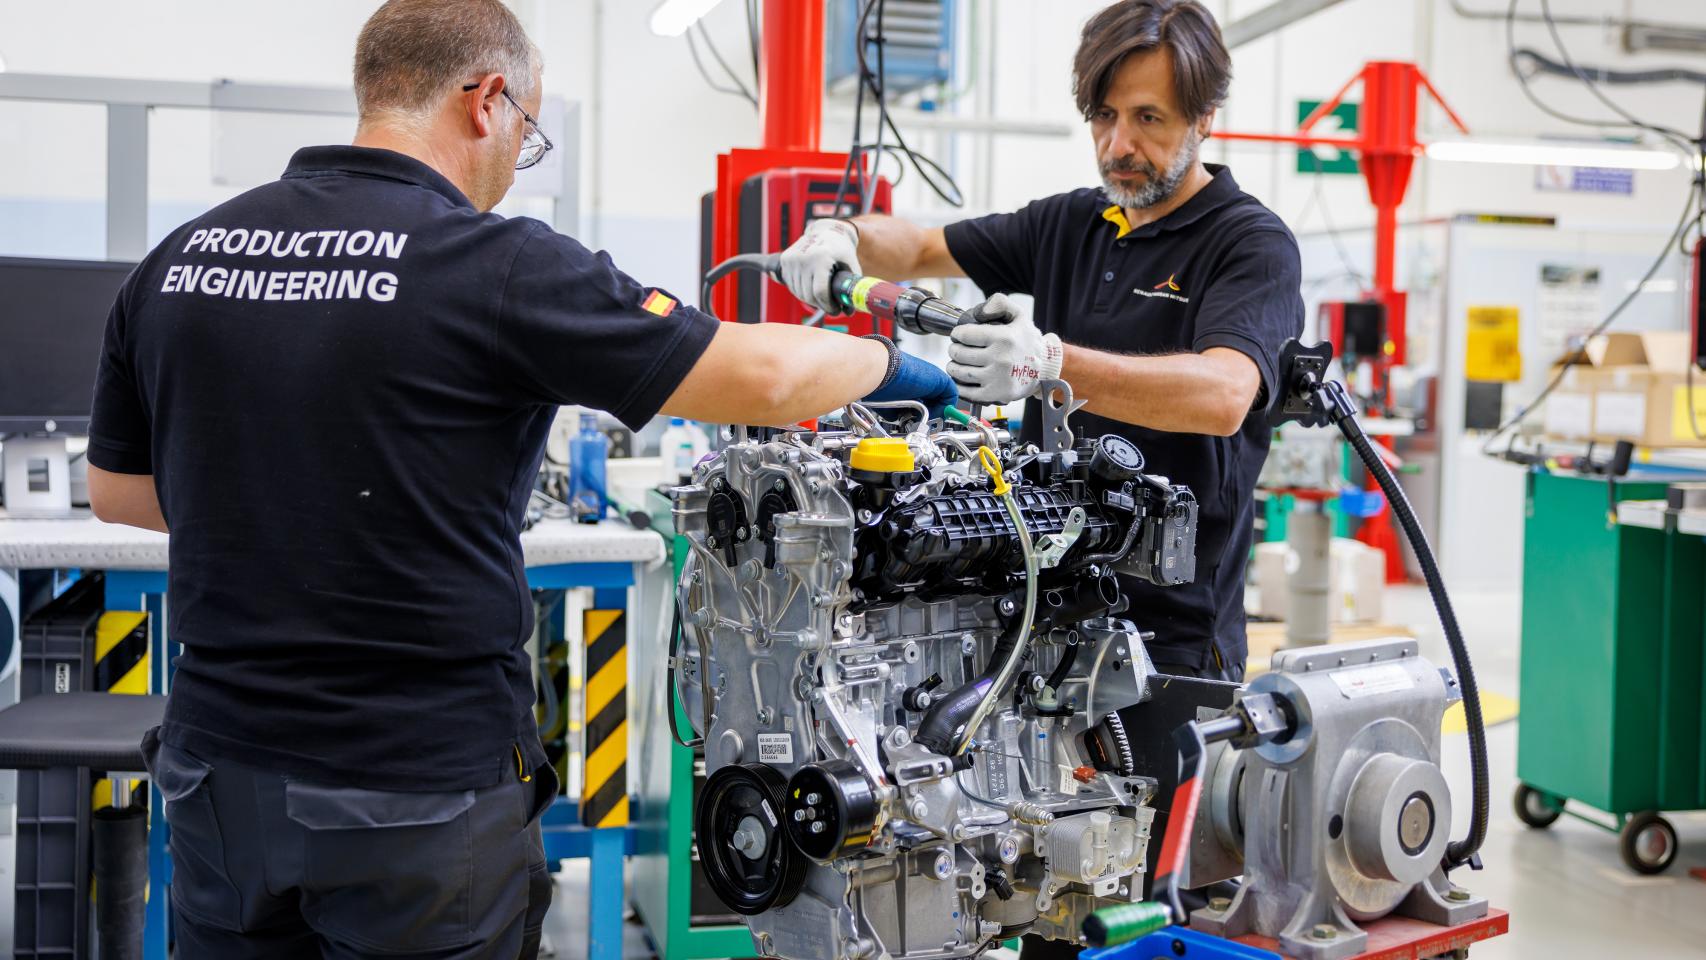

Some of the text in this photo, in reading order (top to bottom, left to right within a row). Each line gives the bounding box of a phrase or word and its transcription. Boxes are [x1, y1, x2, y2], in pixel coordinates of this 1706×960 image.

[182, 228, 409, 259] PRODUCTION
[160, 265, 399, 302] ENGINEERING
[1010, 364, 1039, 381] HyFlex
